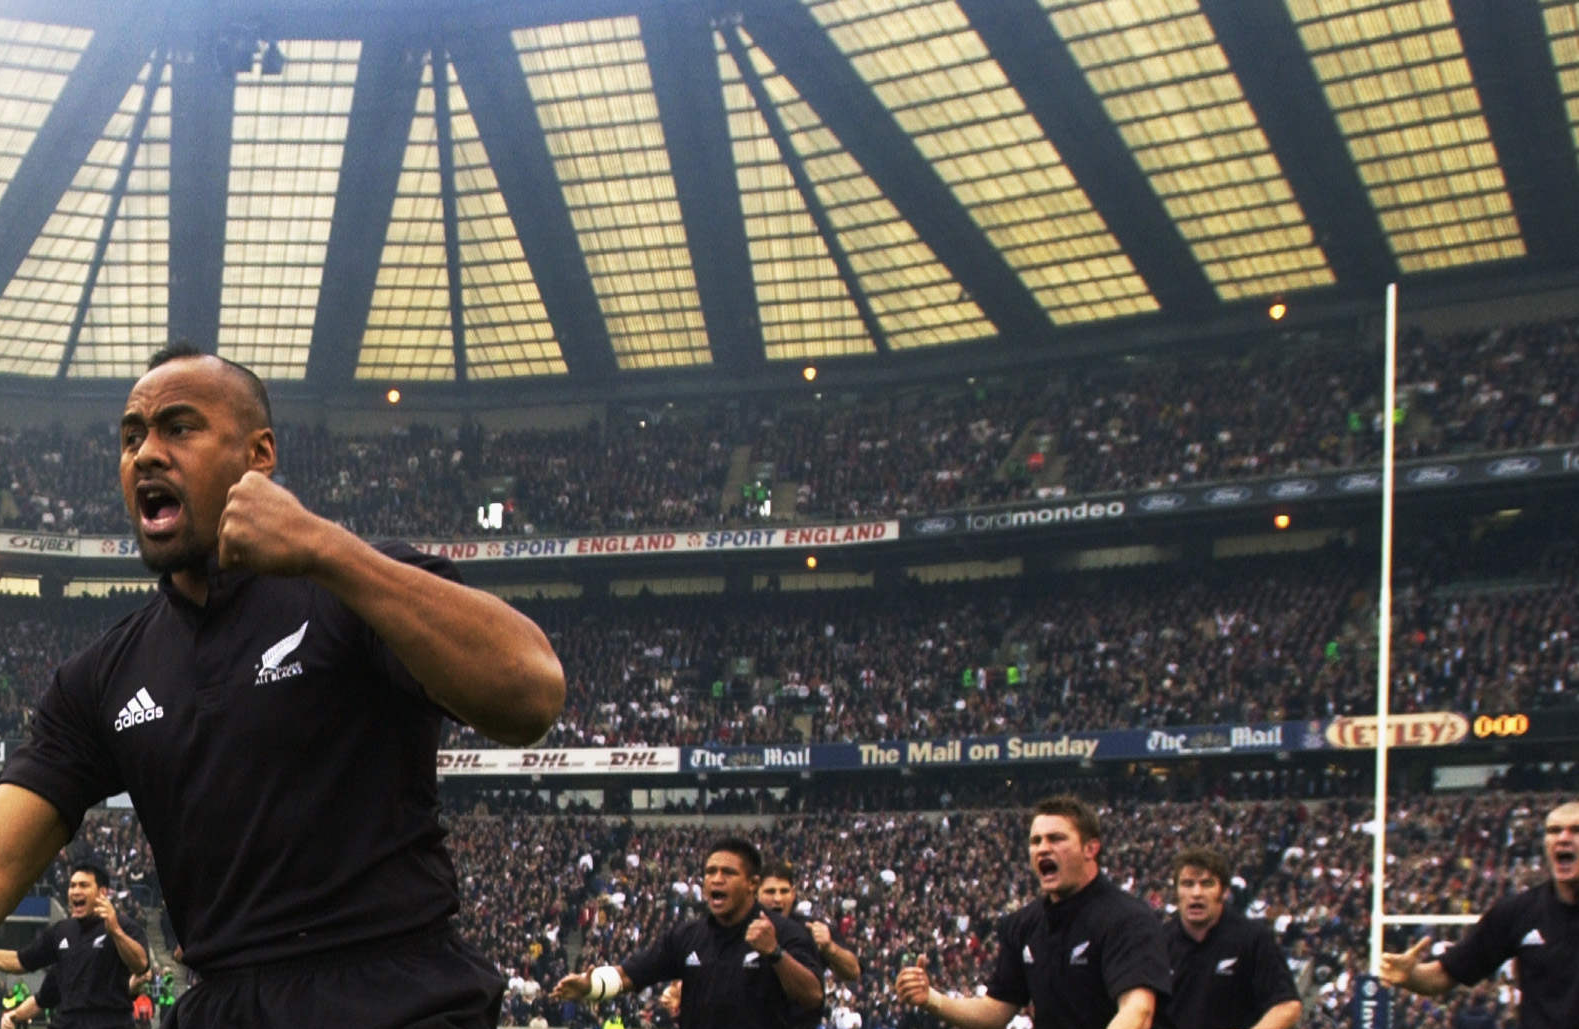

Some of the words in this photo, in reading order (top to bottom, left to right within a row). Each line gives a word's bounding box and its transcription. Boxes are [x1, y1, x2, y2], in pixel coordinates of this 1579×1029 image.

[966, 501, 1126, 531] fordmondeo
[29, 537, 77, 553] CYBEX
[503, 539, 570, 557] SPORT
[577, 533, 677, 554] ENGLAND
[706, 529, 778, 548] SPORT
[784, 522, 887, 545] ENGLAND
[114, 705, 164, 732] adidas
[1230, 726, 1283, 747] Mail
[521, 752, 570, 768] DHL
[609, 751, 660, 767] DHL
[763, 747, 811, 767] Mail
[859, 744, 899, 765] The
[907, 740, 962, 764] Mail
[969, 742, 1000, 760] on
[1007, 735, 1100, 759] Sunday
[437, 754, 483, 768] DHL
